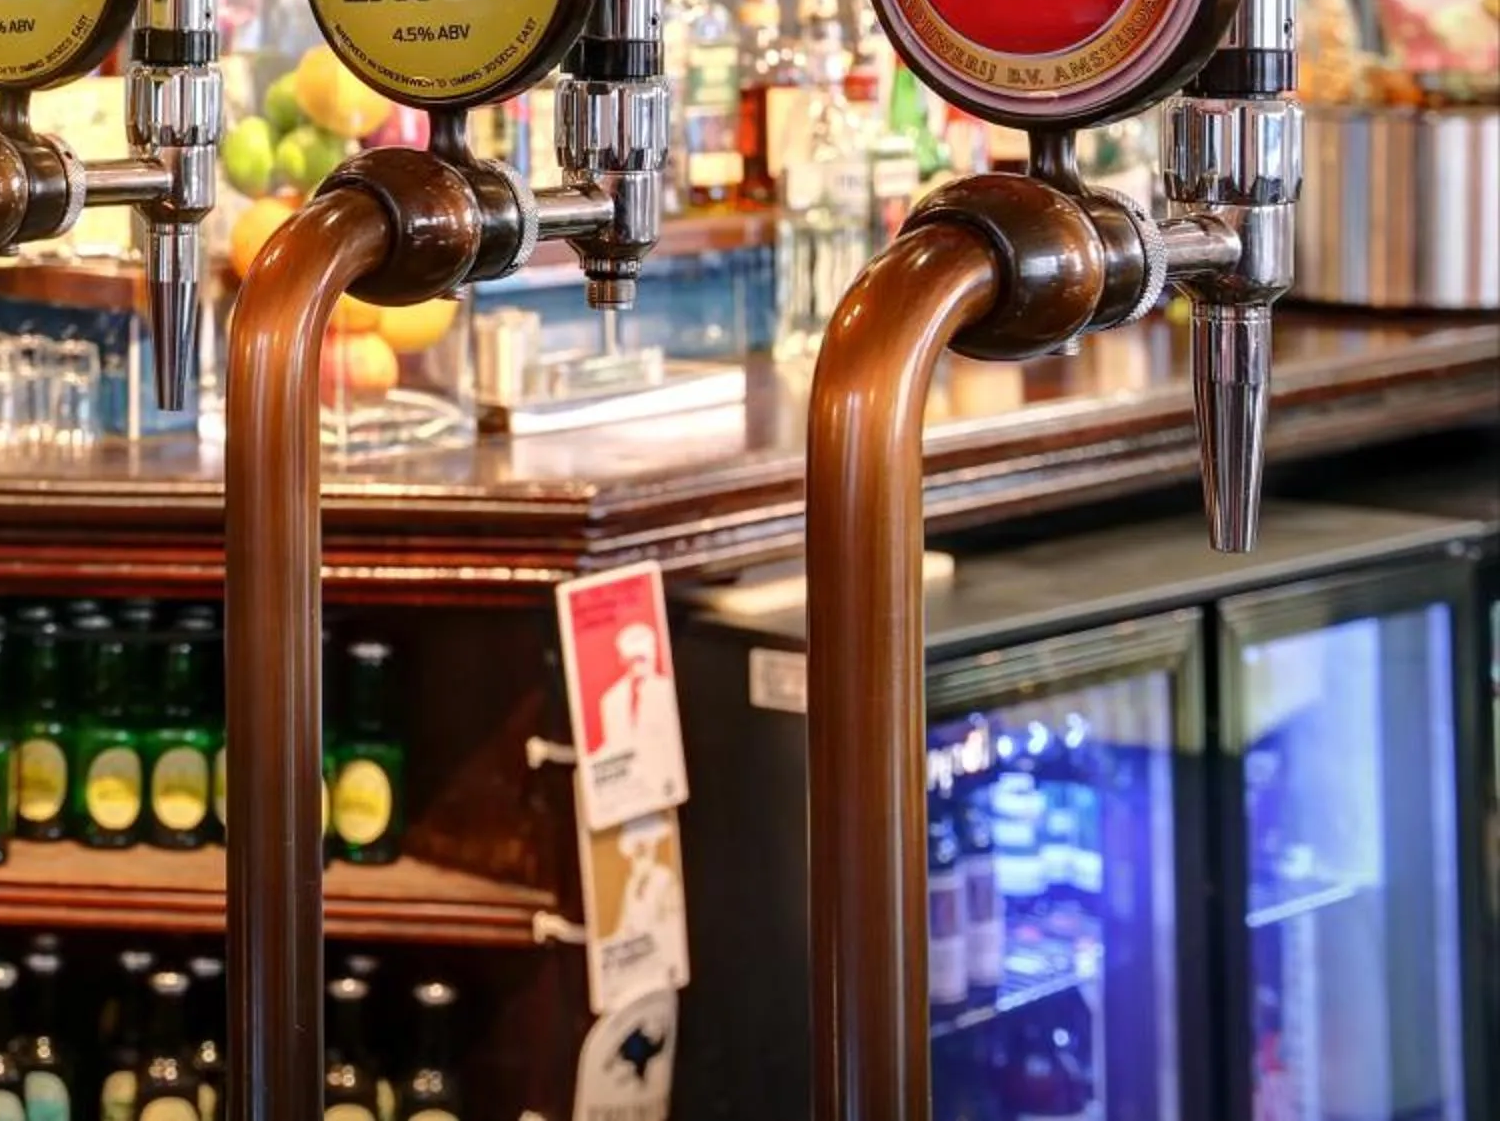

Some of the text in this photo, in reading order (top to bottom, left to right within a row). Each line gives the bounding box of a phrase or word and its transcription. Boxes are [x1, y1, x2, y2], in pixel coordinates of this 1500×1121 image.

[9, 18, 37, 33] ABV
[392, 24, 471, 42] 4.5% ABV
